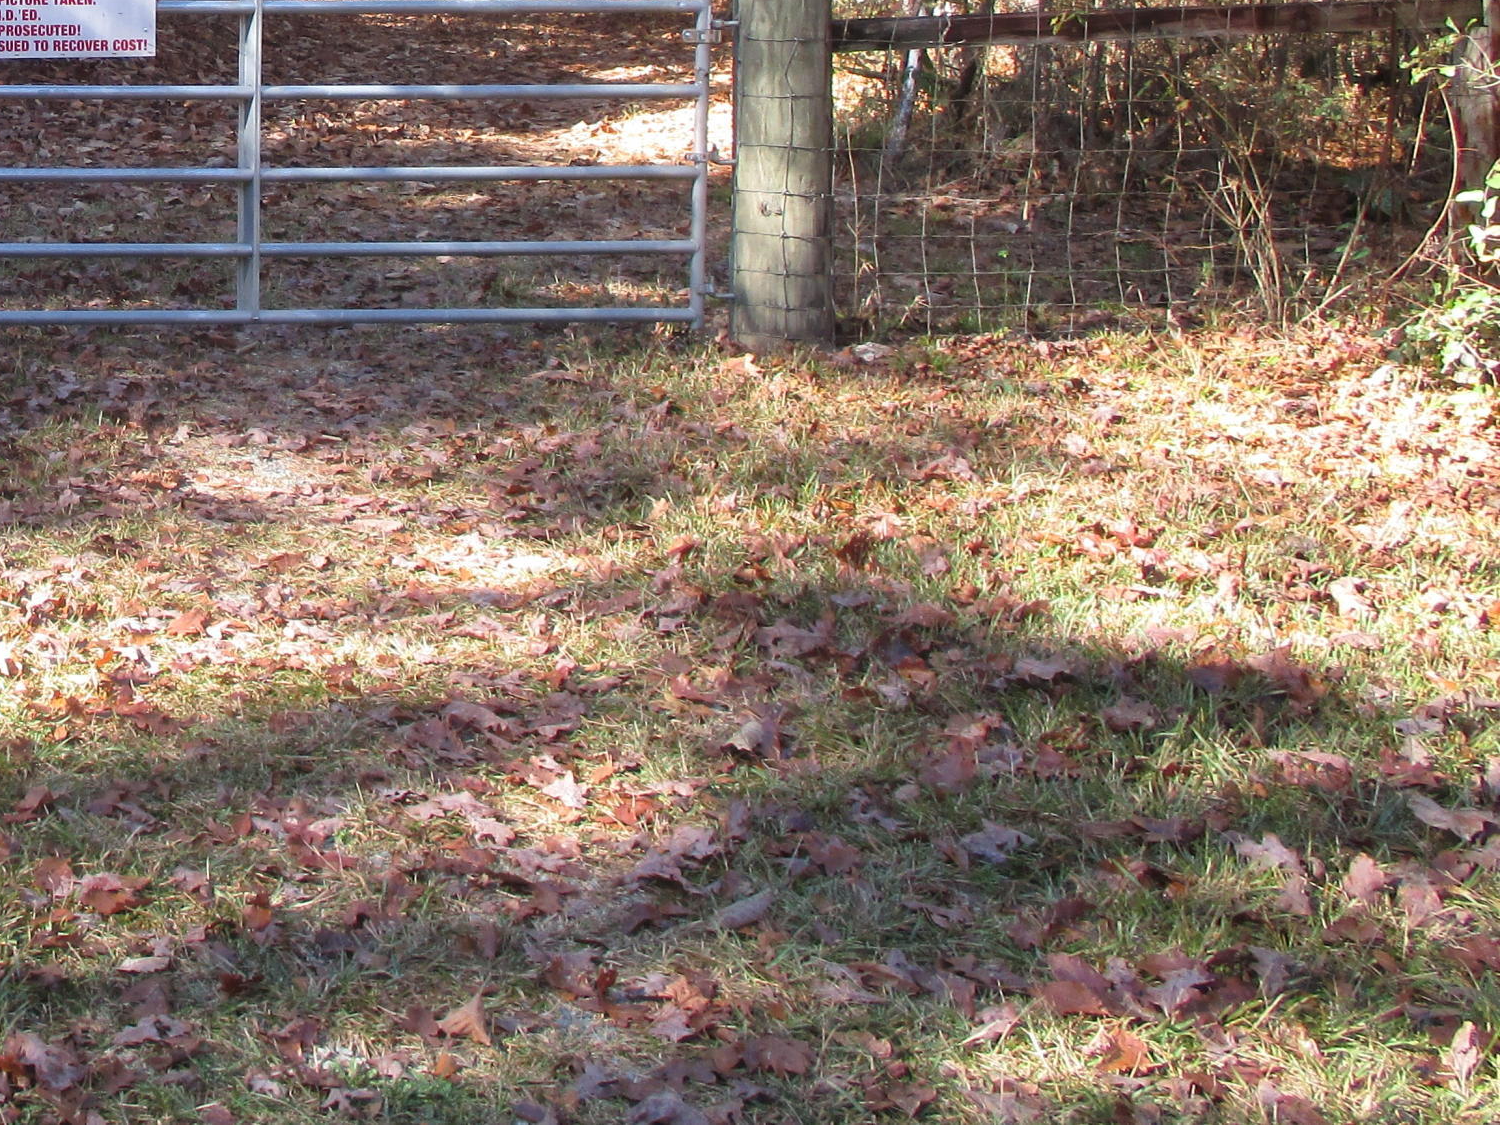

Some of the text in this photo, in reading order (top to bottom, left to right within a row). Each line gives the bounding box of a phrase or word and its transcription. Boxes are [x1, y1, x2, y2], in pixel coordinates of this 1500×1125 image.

[34, 40, 49, 52] TO
[53, 40, 108, 52] RECOVER
[112, 39, 148, 51] COST!
